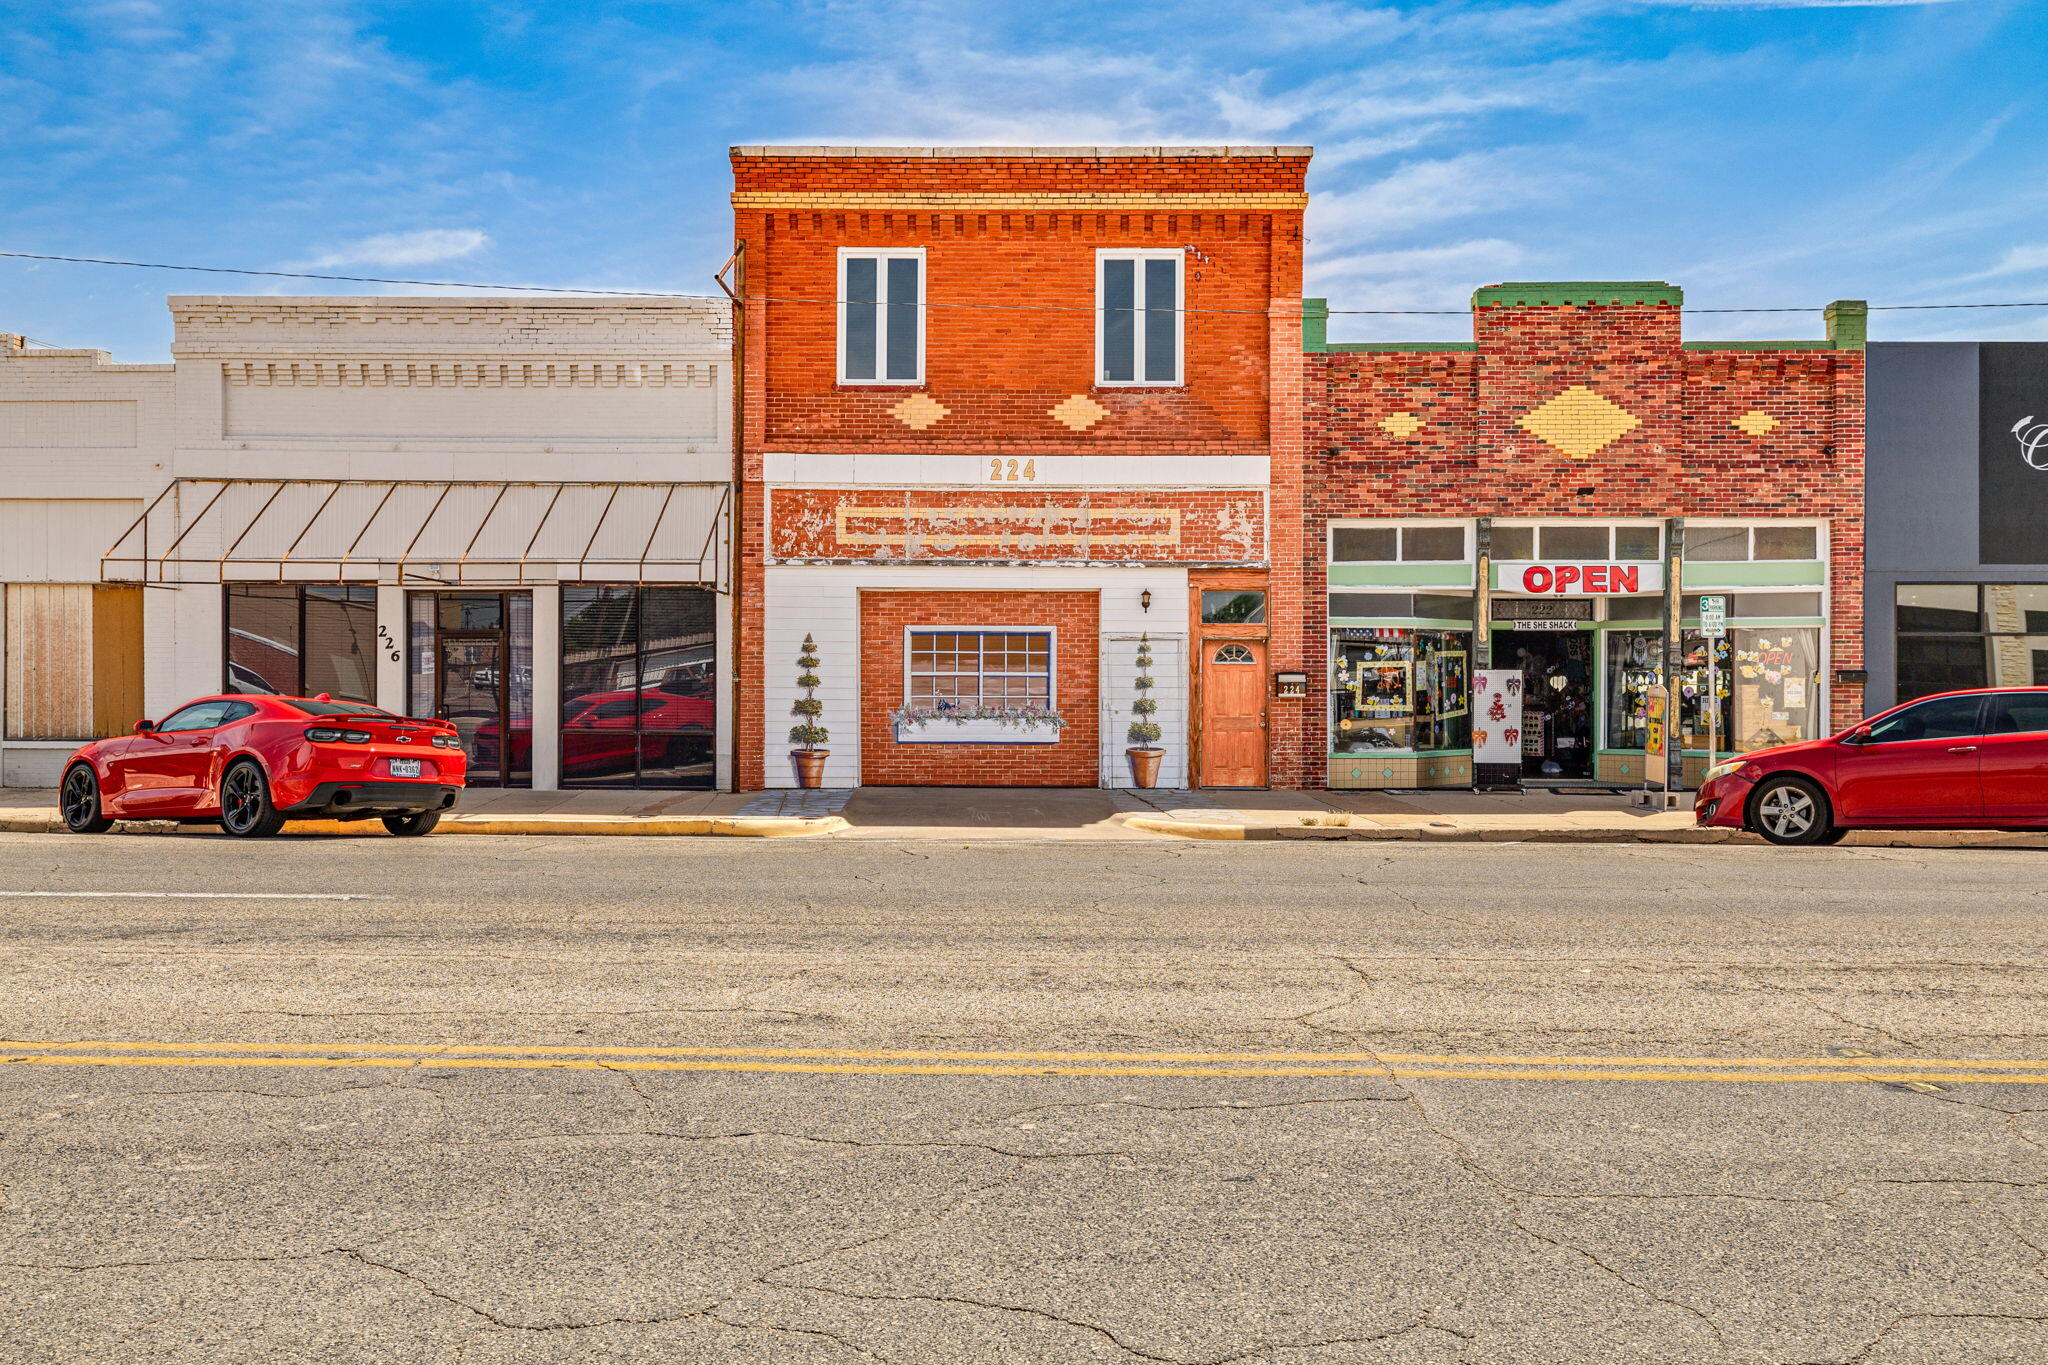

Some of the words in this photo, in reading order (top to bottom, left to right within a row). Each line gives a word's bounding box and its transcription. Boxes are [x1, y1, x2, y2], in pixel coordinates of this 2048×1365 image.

[990, 458, 1036, 481] 224
[1522, 565, 1639, 593] OPEN
[1531, 604, 1553, 615] 222
[1702, 599, 1709, 610] 3
[1517, 621, 1532, 629] THE
[1532, 621, 1547, 629] SHE
[1548, 621, 1573, 629] SHACK
[378, 625, 401, 662] 226
[1758, 651, 1793, 665] OPEN
[1283, 685, 1300, 695] 224
